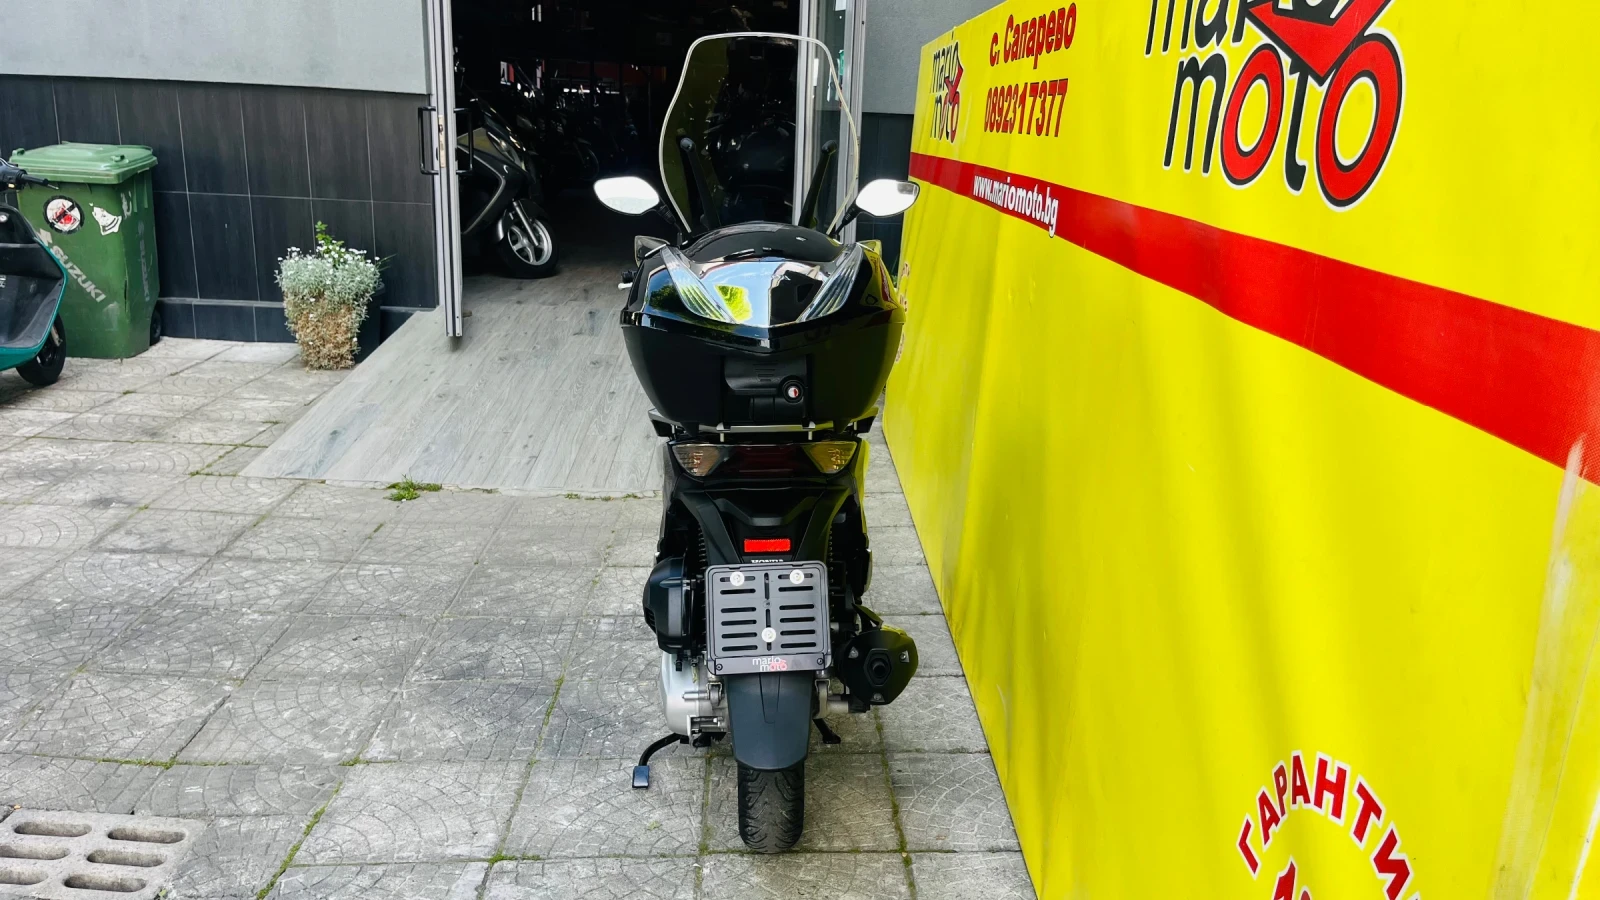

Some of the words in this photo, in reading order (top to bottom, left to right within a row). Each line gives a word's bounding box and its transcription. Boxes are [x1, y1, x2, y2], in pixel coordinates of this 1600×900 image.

[1003, 2, 1077, 69] Сапарево
[930, 91, 960, 143] moto
[984, 78, 1069, 137] 0892317377
[1164, 33, 1403, 207] moto
[973, 176, 1059, 238] www.mariomoto.bg
[50, 245, 106, 302] SUZUKI
[752, 656, 781, 666] mario
[760, 662, 787, 672] moto
[1237, 751, 1420, 900] ГАРАНТИ
